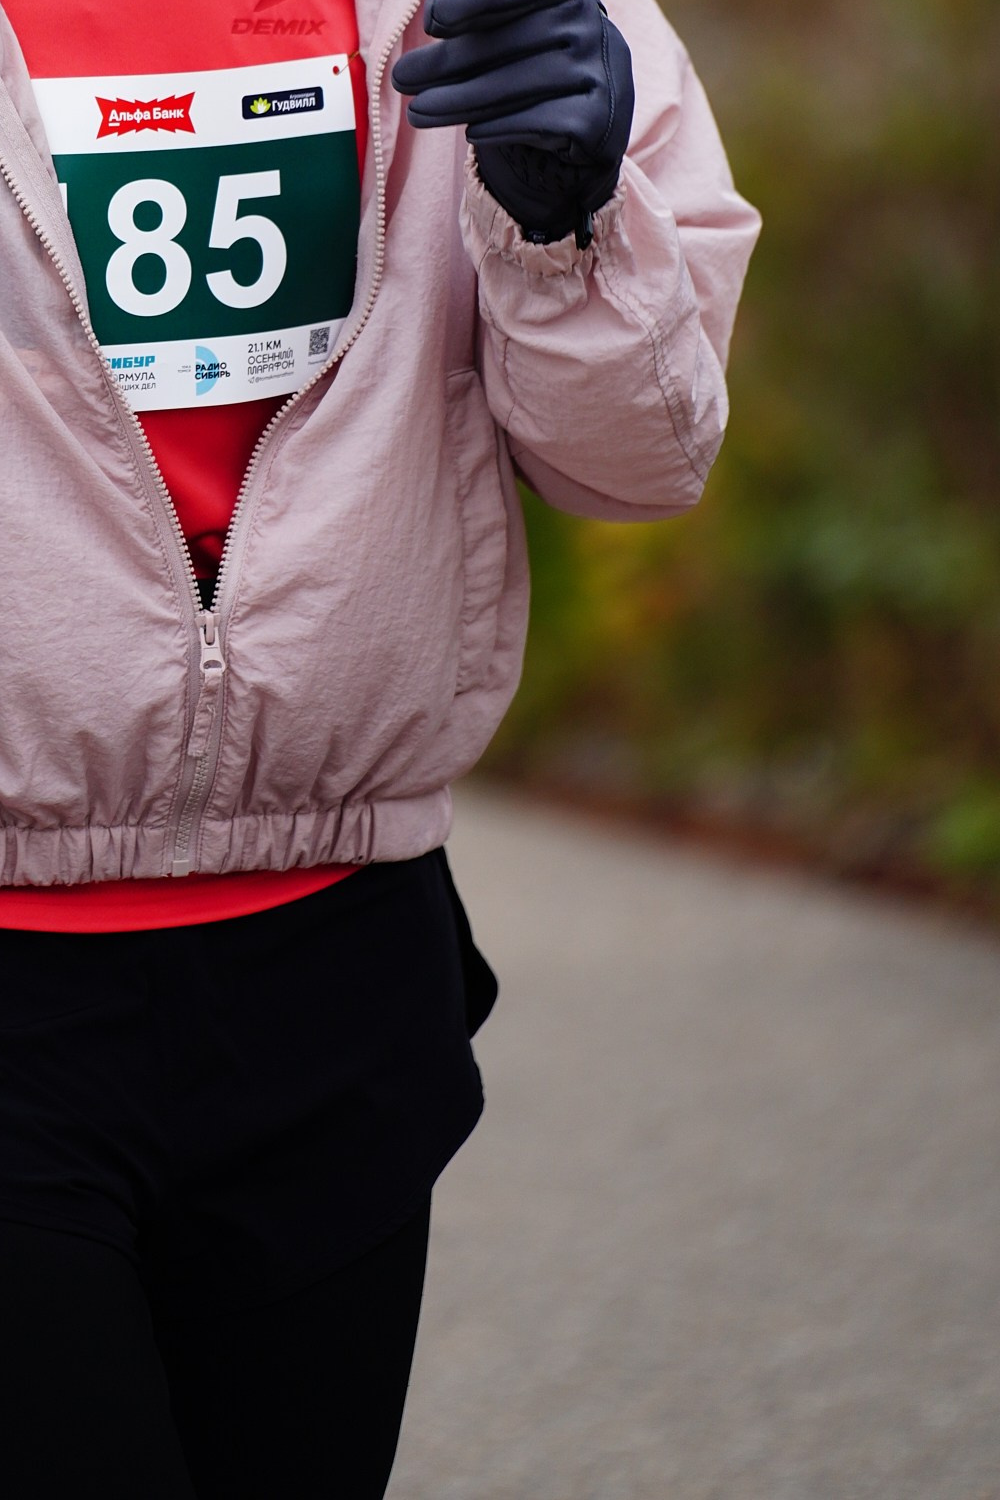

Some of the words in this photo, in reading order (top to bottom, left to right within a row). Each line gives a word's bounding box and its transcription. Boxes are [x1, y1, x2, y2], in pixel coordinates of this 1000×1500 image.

[231, 18, 327, 36] DEMIX
[108, 108, 151, 124] Альфа
[152, 106, 185, 120] Банк
[59, 169, 287, 317] 85
[247, 343, 264, 353] 21.1
[105, 355, 155, 369] ИБУР
[247, 348, 293, 365] ОСЕННИЙ
[195, 362, 227, 372] РАДИО
[194, 370, 231, 381] СИБИРЬ
[121, 383, 140, 392] ШИХ
[140, 382, 157, 391] ДЕЛ
